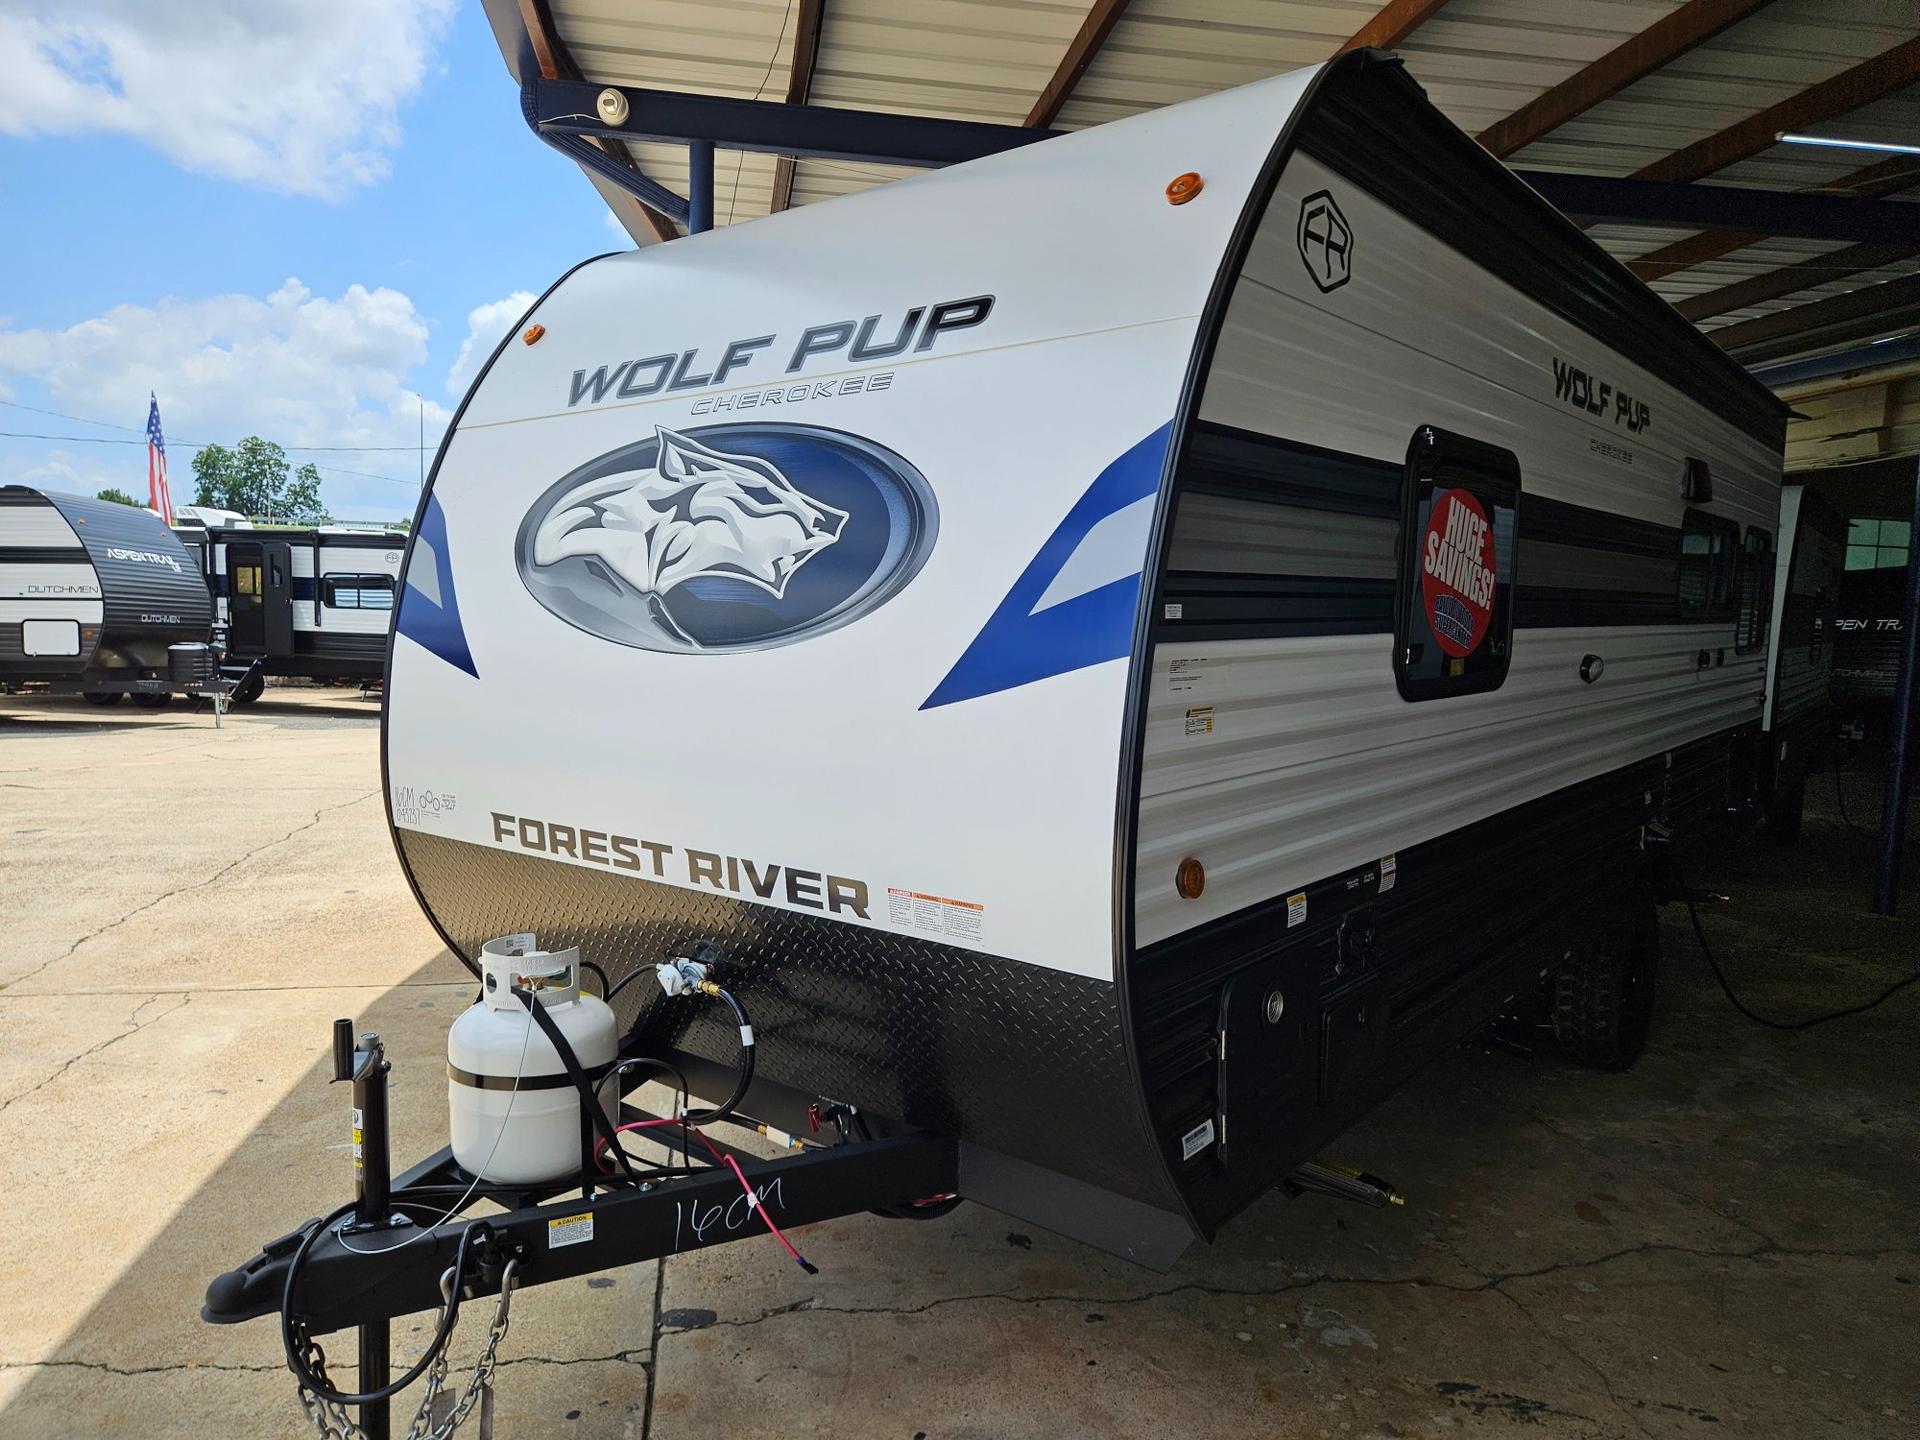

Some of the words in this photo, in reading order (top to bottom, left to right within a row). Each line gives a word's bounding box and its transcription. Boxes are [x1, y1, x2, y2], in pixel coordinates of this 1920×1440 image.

[568, 334, 776, 408] WOLF
[786, 294, 996, 374] PUP
[690, 371, 895, 416] CHEROKEE
[1552, 356, 1612, 418] WOLF
[1615, 391, 1651, 435] PUP
[107, 547, 146, 562] ASPEN
[144, 552, 179, 566] TRAIL
[1444, 495, 1488, 567] HUGE
[27, 585, 99, 594] DUTCHMEN
[1424, 530, 1496, 611] SAVINGS!
[141, 614, 181, 624] DUTCHMEN
[490, 811, 673, 876] FOREST
[683, 847, 872, 921] RIVER
[562, 1215, 587, 1225] CAUTION
